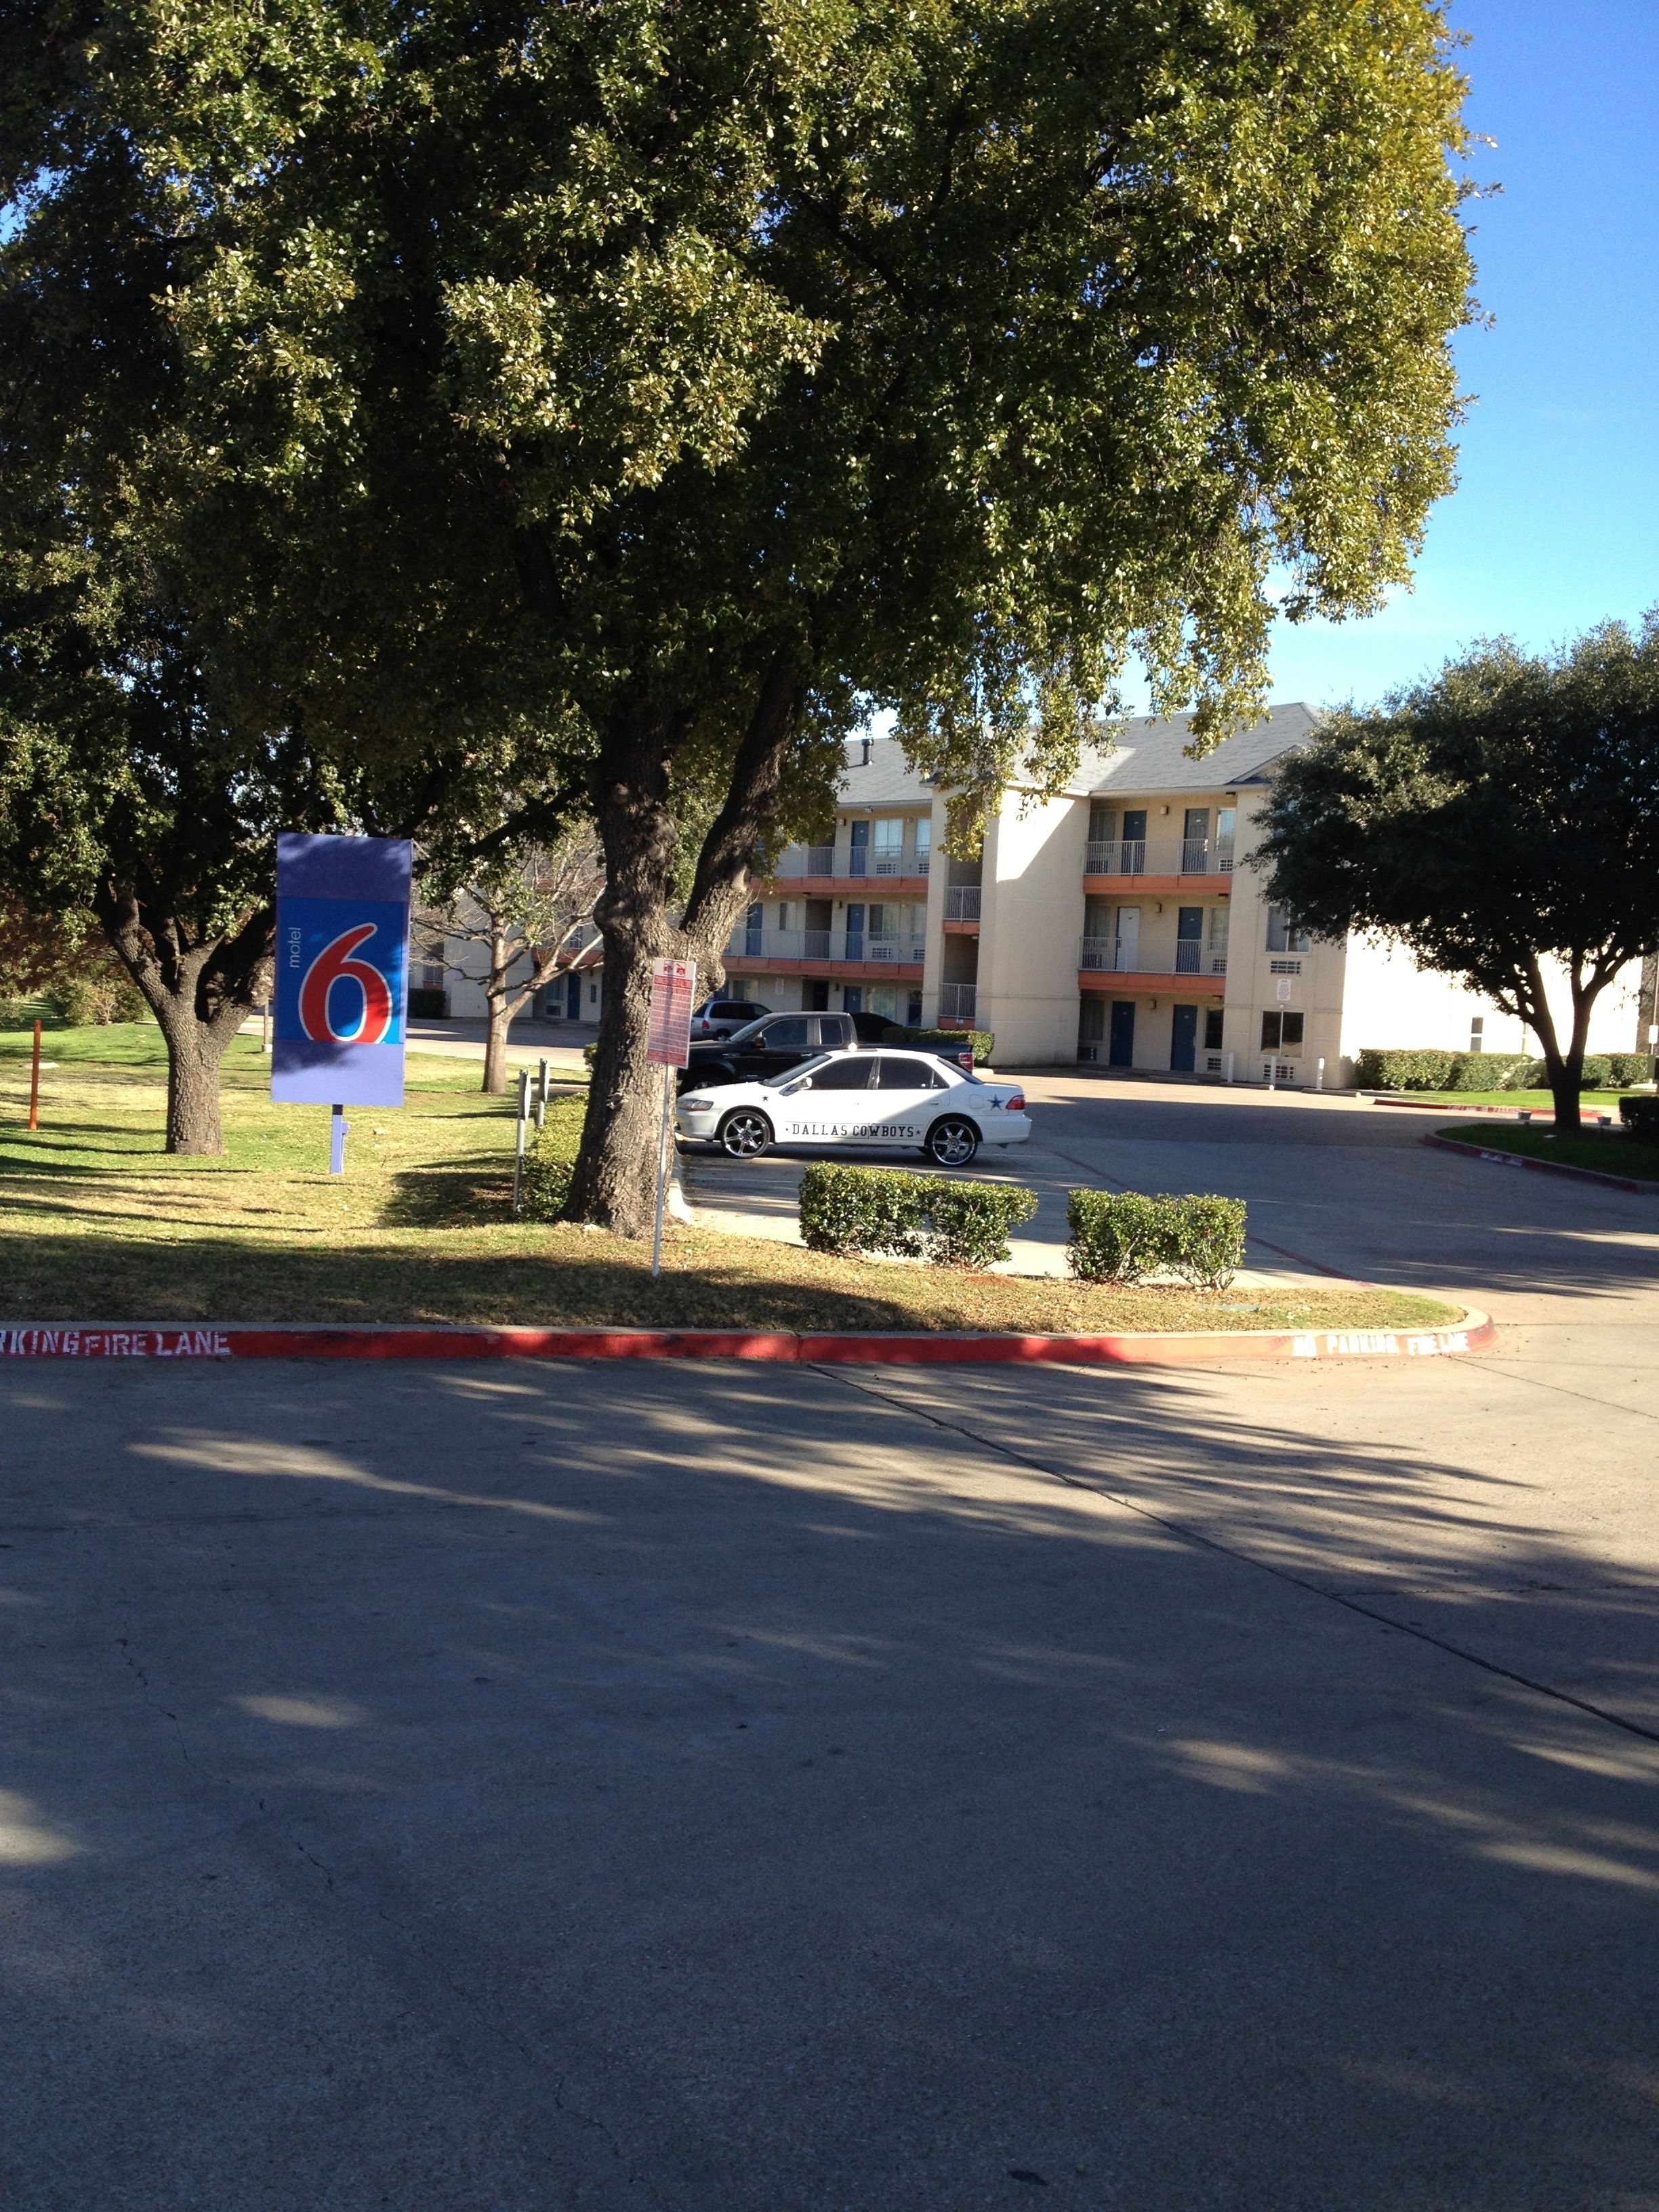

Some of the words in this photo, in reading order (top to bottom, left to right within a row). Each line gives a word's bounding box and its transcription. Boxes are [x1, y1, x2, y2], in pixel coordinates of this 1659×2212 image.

[288, 927, 301, 968] motel
[298, 922, 392, 1044] 6
[792, 1124, 847, 1136] DALLAS
[853, 1125, 914, 1137] COWBOYS
[85, 1333, 147, 1355] FIRE
[156, 1331, 231, 1355] LANE
